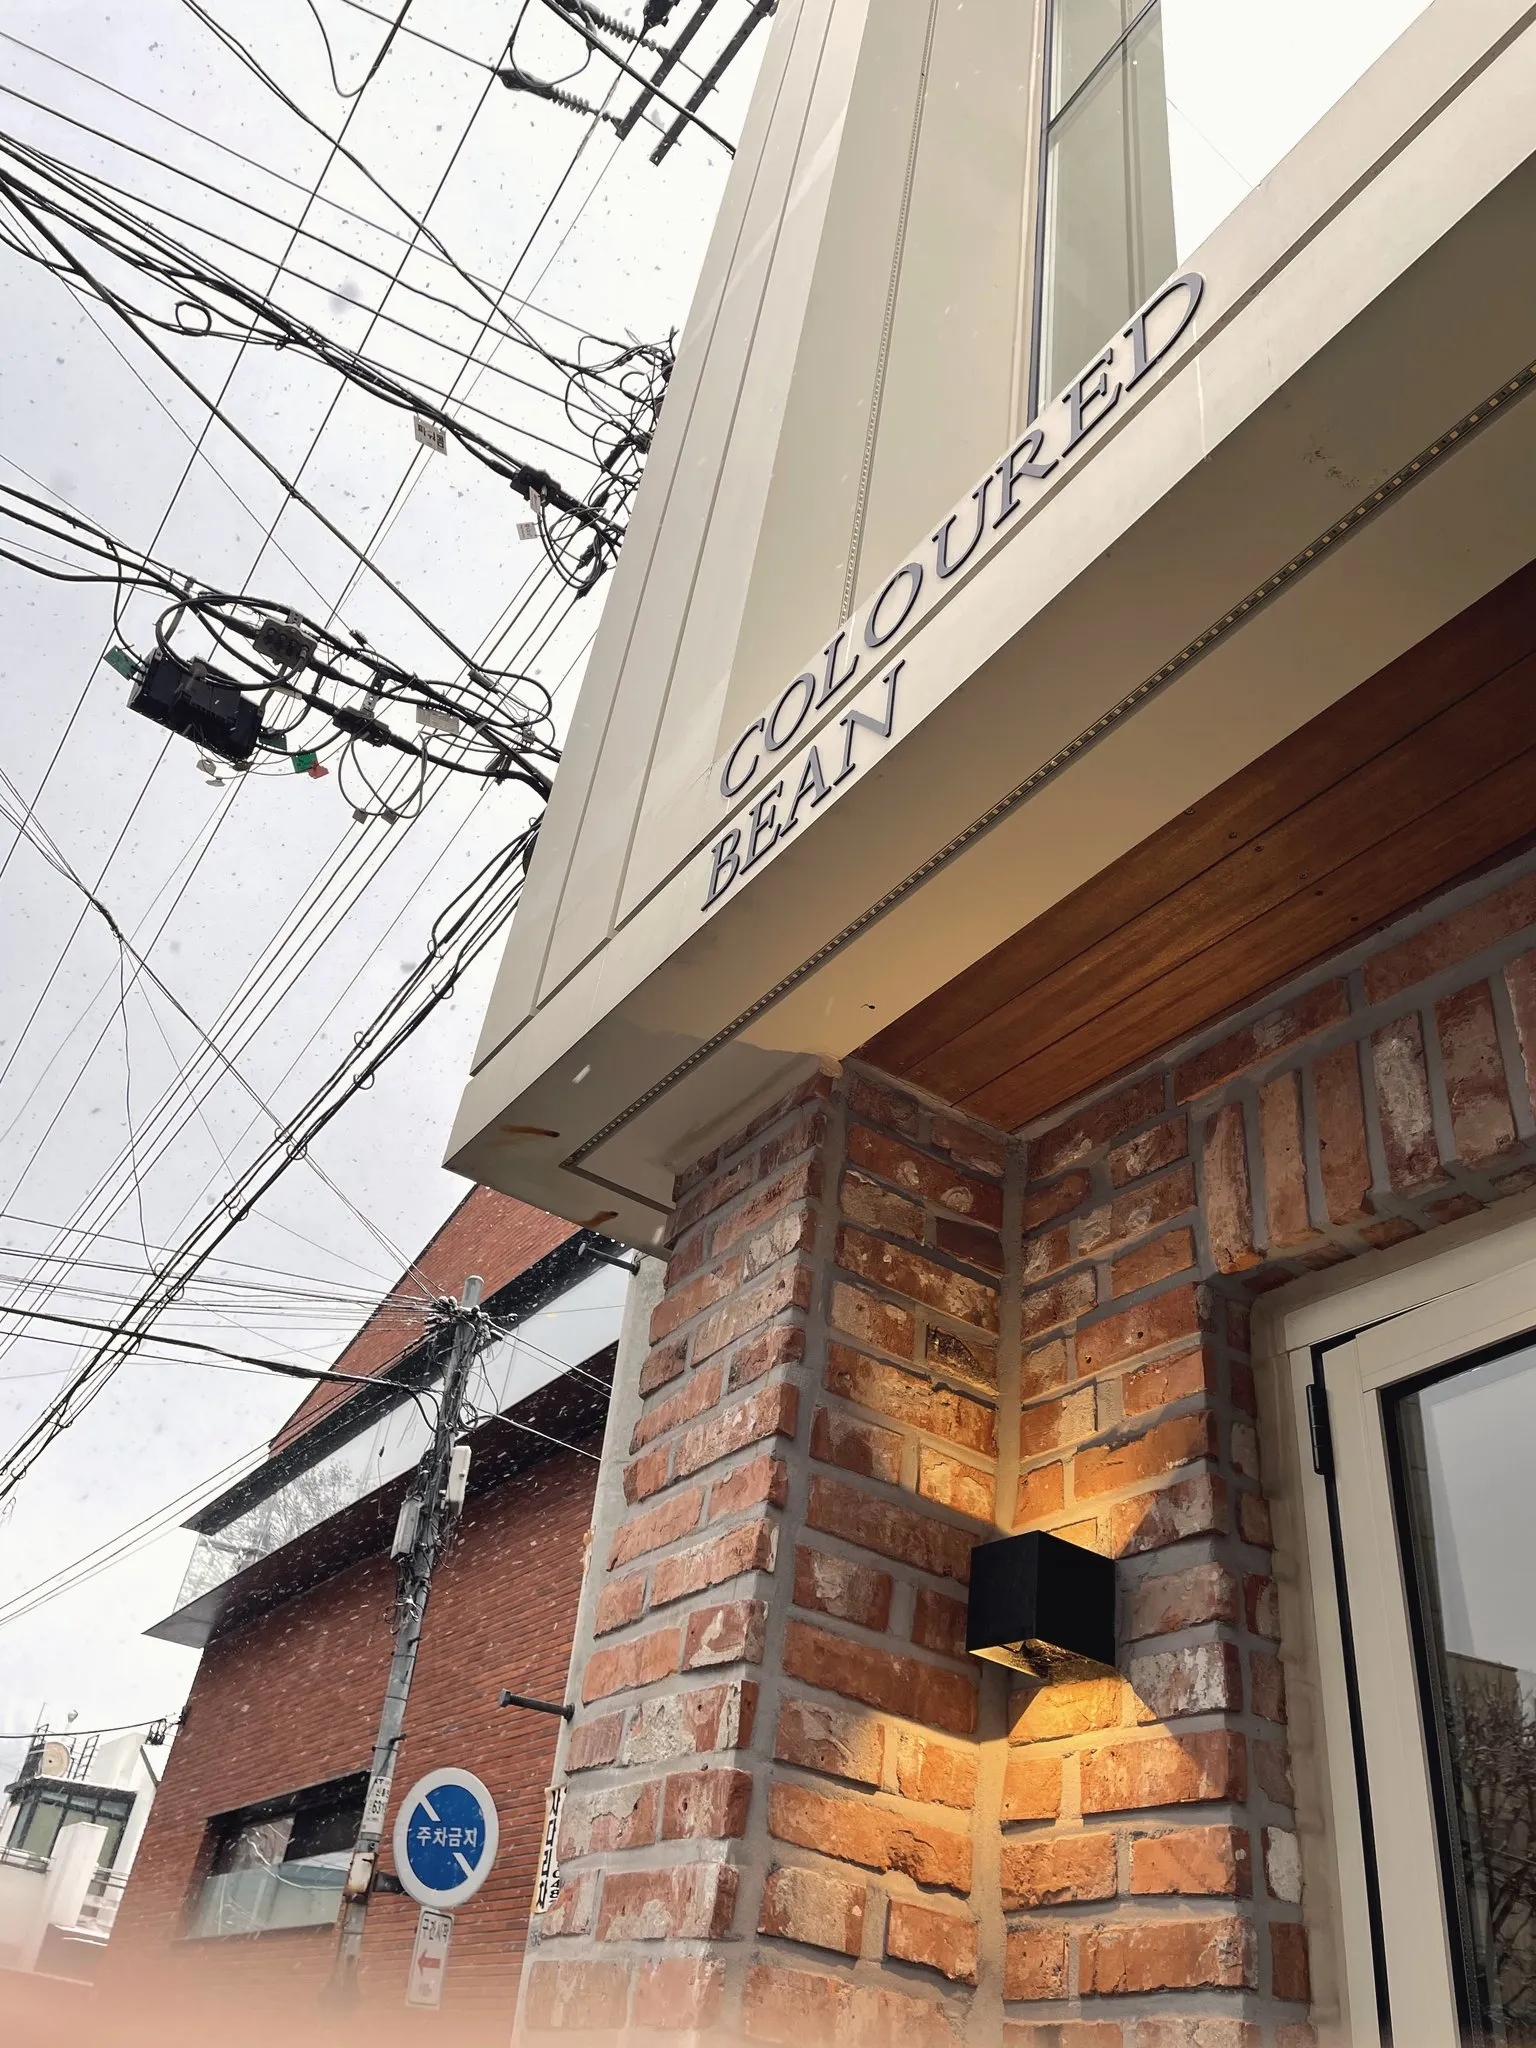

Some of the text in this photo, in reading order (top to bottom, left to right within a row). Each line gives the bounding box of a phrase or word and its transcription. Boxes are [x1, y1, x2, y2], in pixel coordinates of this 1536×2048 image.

[720, 271, 1206, 798] COLOURED
[702, 659, 906, 912] BEAN
[416, 1826, 478, 1848] 주차금지
